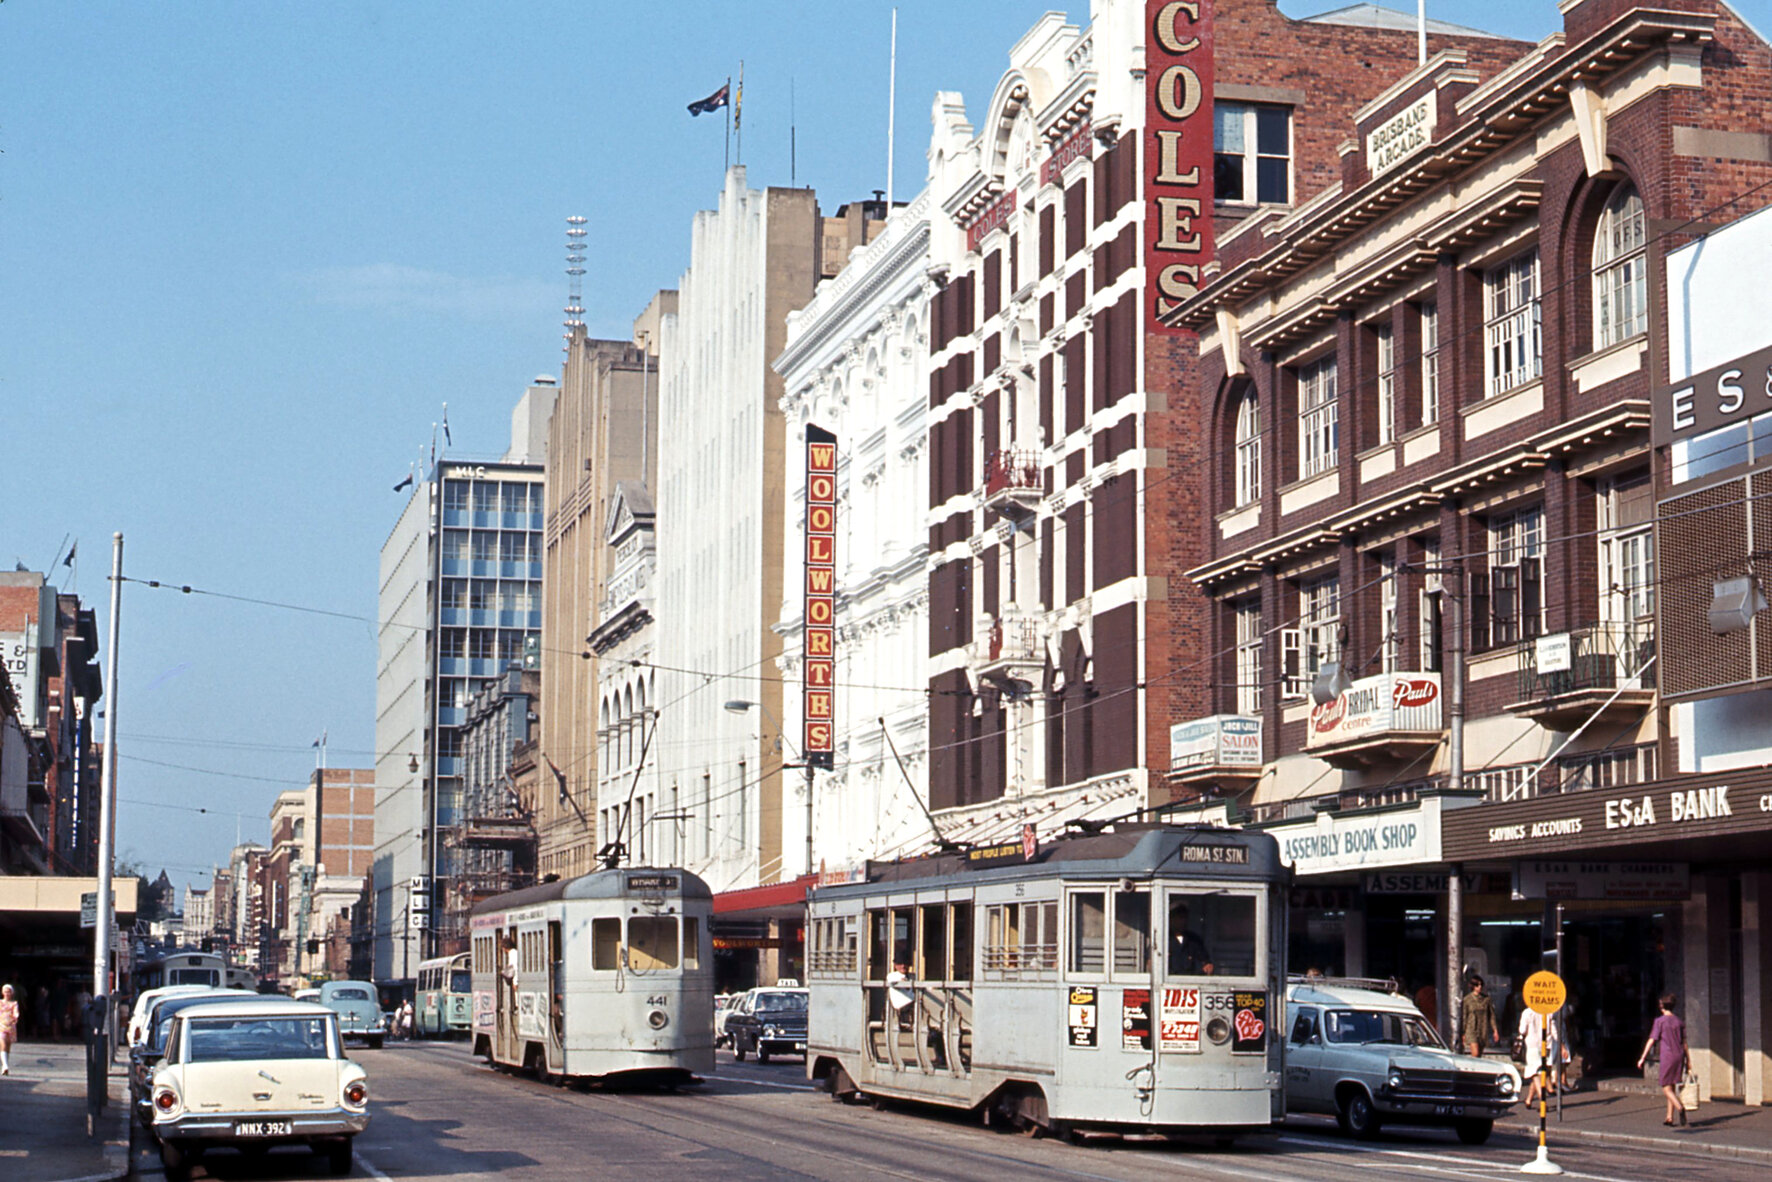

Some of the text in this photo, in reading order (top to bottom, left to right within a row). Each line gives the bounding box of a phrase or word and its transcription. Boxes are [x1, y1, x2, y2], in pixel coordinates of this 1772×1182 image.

[1373, 102, 1427, 153] BRISBANE
[1155, 1, 1202, 320] COLES
[1377, 127, 1426, 171] ARCADE
[974, 202, 1013, 243] COLES
[456, 466, 486, 477] MLC
[810, 446, 835, 747] WOOLWORTHS
[1348, 686, 1380, 716] BRIDAL
[1342, 715, 1371, 731] centre
[1222, 735, 1259, 748] SALON
[1488, 824, 1525, 842] SAVINGS
[1531, 818, 1582, 838] ACCOUNTS
[1671, 785, 1732, 822] BANK
[1183, 846, 1211, 861] ROMA
[1285, 823, 1417, 860] ASSEMBLY BOOK SHOP
[646, 996, 667, 1006] 441
[1204, 996, 1234, 1010] 356
